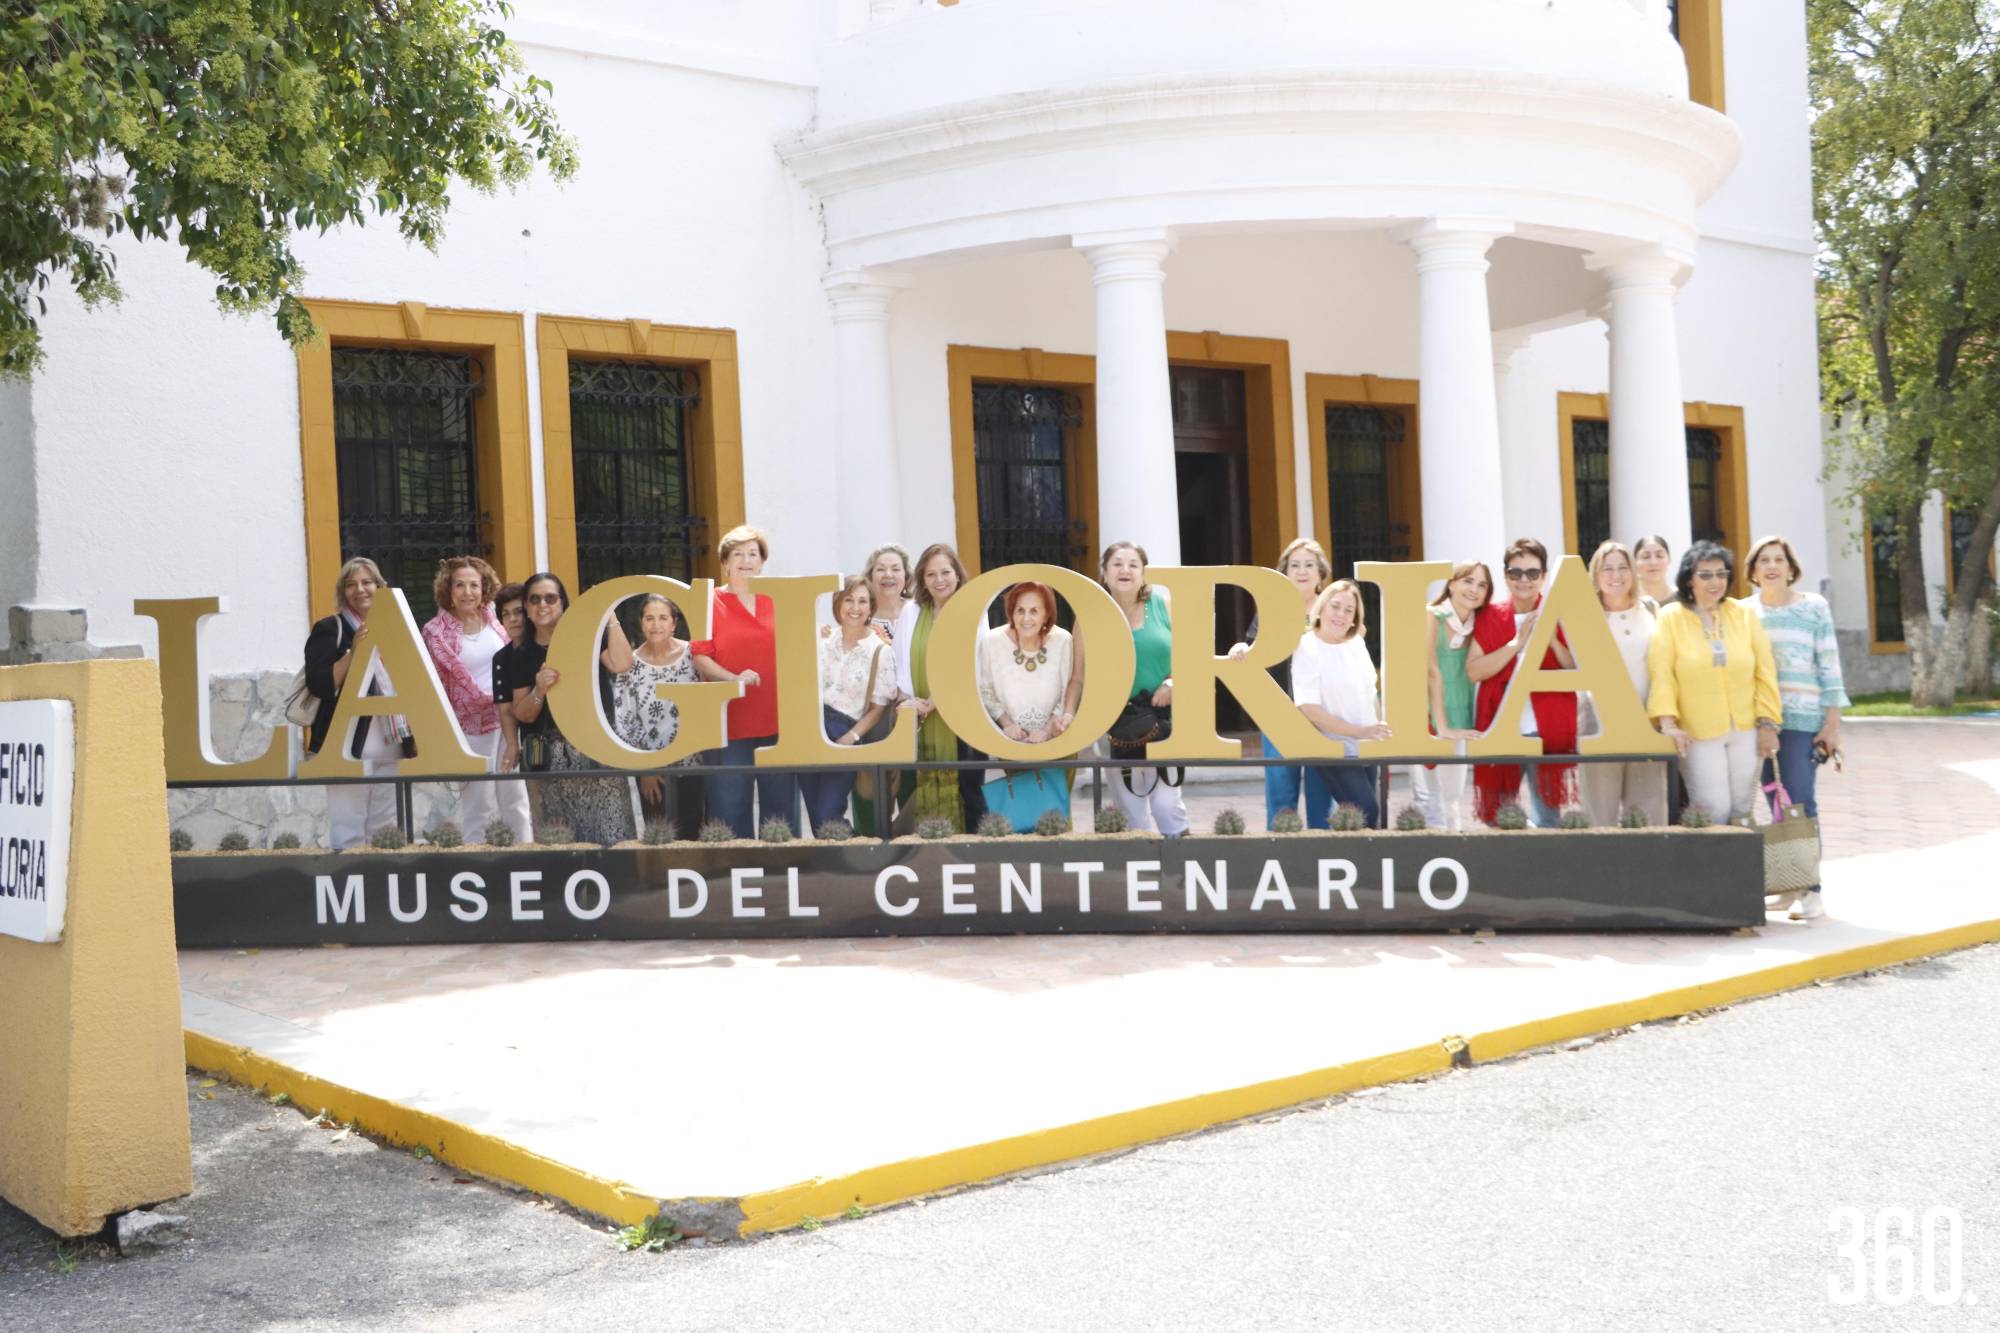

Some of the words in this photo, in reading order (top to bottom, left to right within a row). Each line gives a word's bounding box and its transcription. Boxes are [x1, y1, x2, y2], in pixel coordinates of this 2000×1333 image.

[134, 587, 489, 781] LA
[547, 555, 1677, 770] GLORIA
[315, 868, 611, 924] MUSEO
[668, 866, 820, 918] DEL
[874, 857, 1470, 917] CENTENARIO
